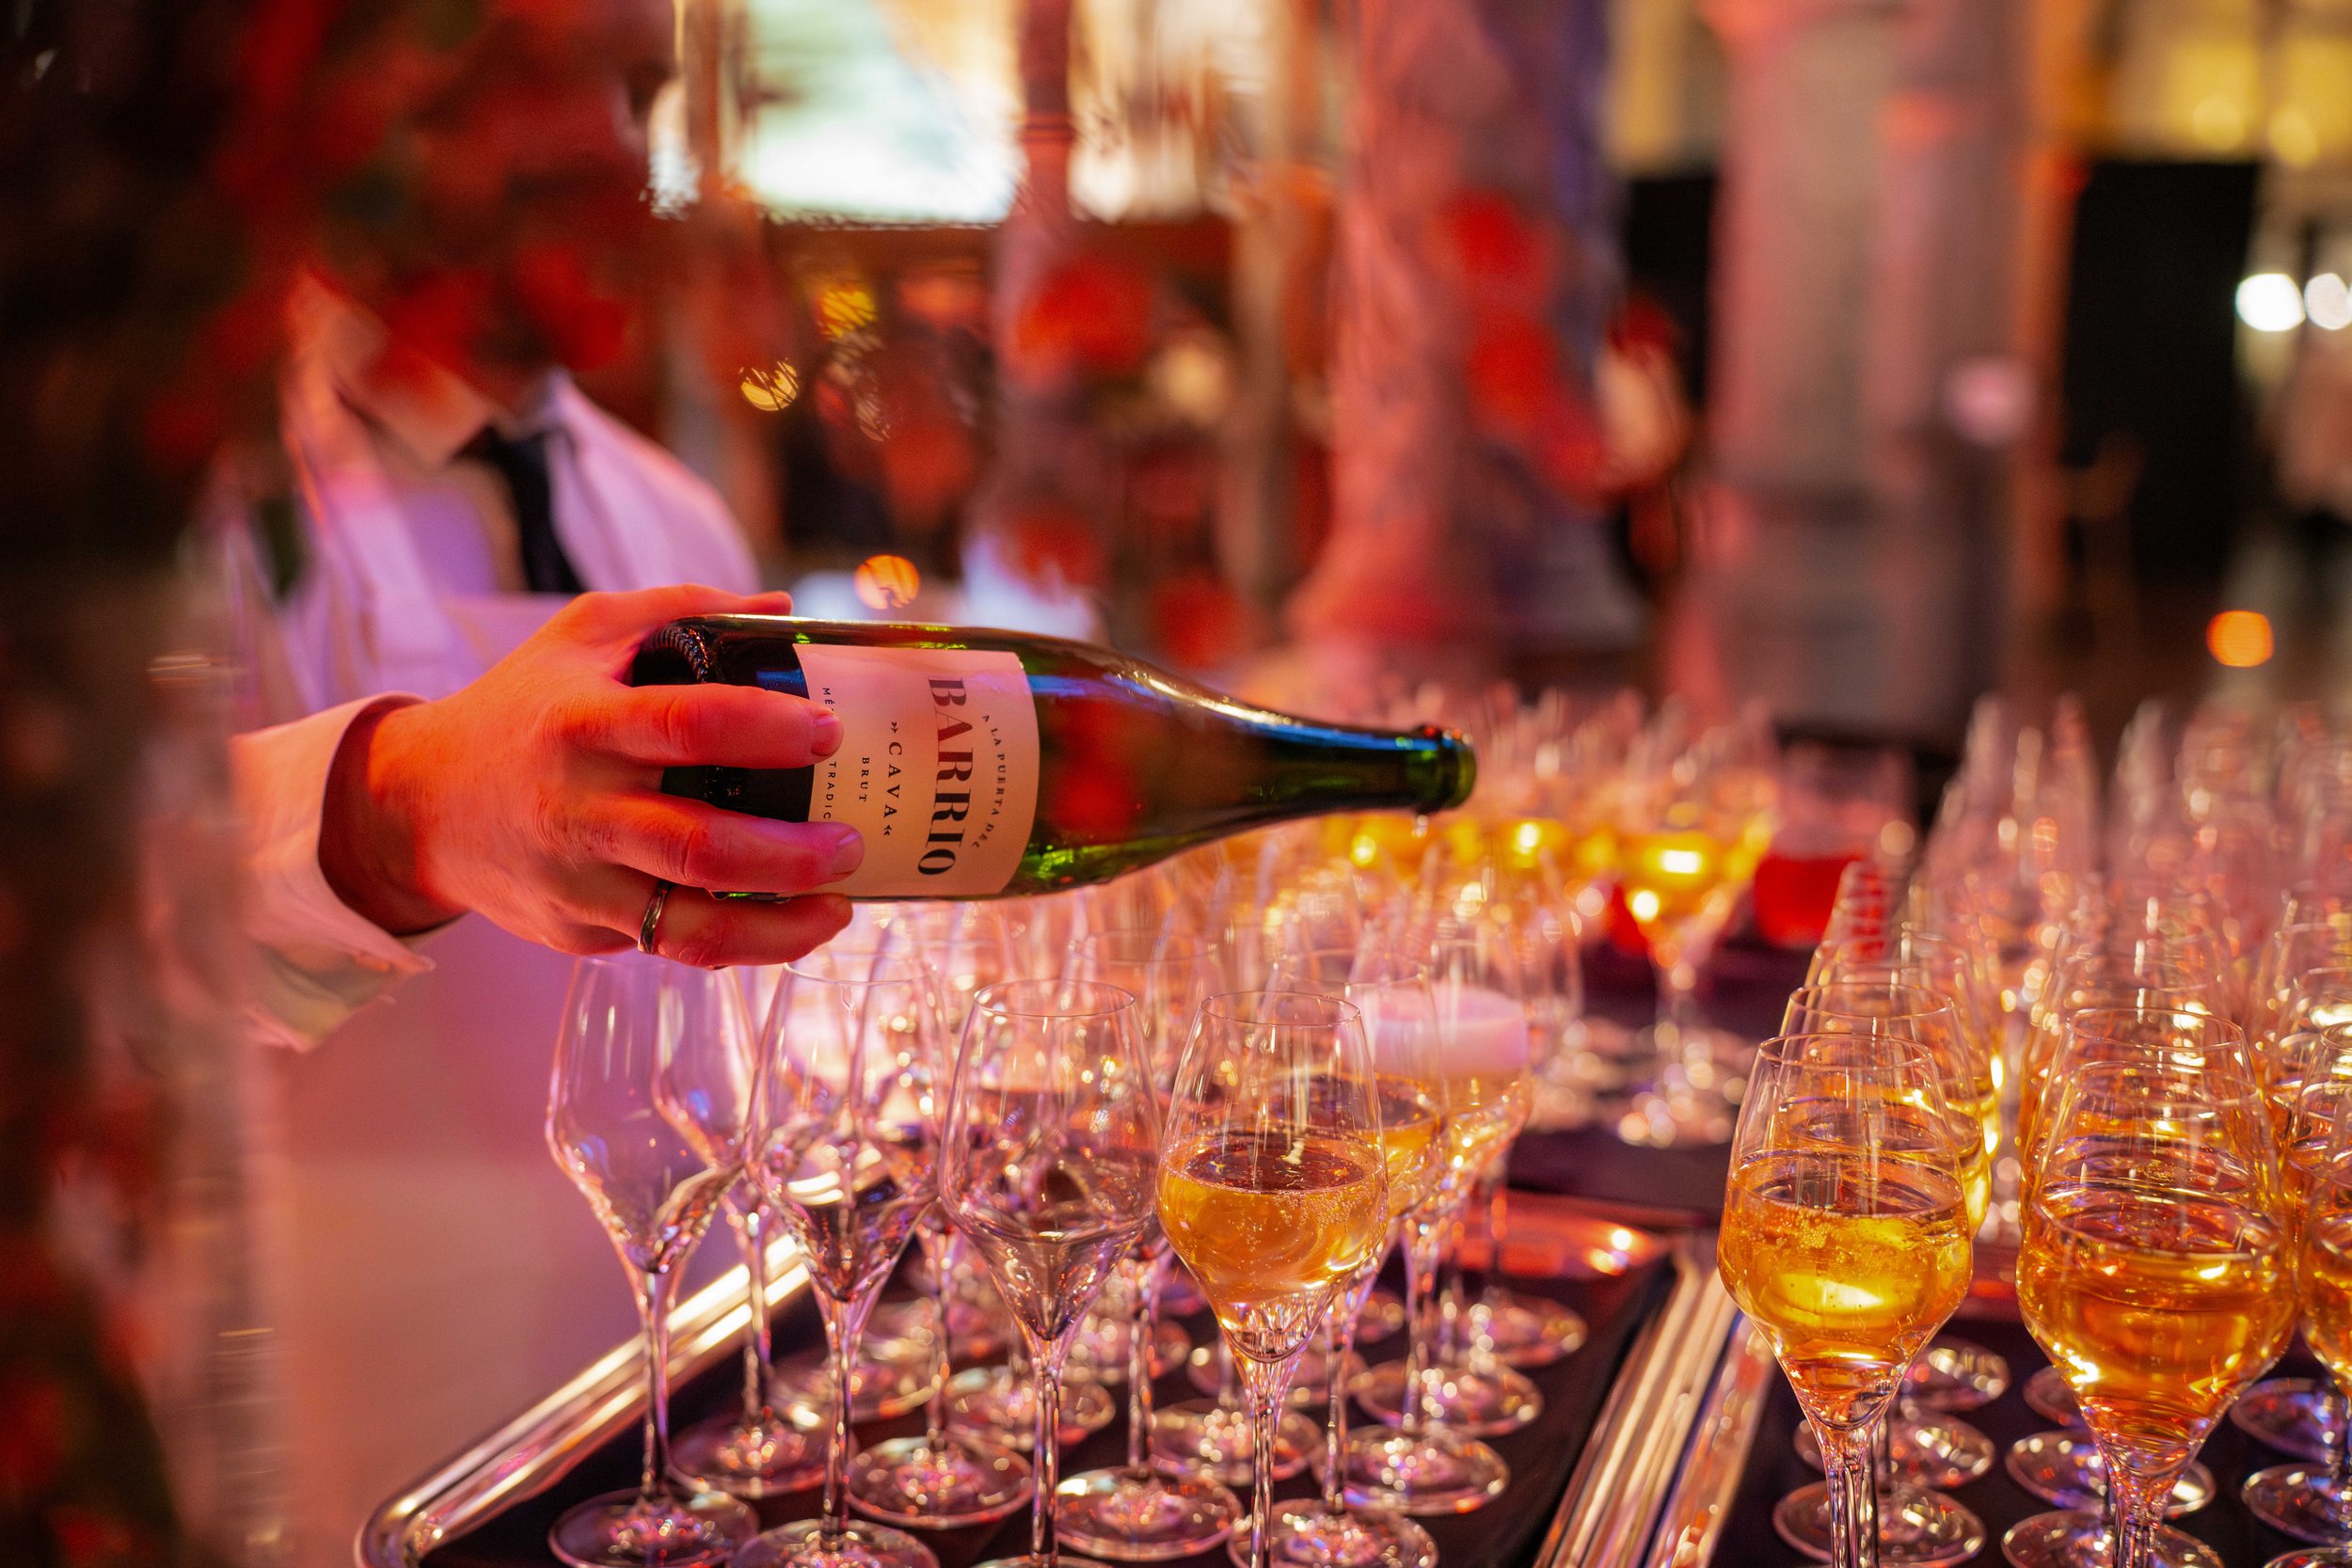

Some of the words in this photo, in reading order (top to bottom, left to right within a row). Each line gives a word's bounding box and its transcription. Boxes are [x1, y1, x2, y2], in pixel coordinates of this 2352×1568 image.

[981, 714, 991, 722] A
[991, 728, 1002, 746] LA
[822, 761, 837, 820] TRADIC
[858, 757, 870, 802] BRUT
[882, 741, 903, 818] CAVA
[917, 677, 974, 876] BARRIO
[991, 753, 1007, 816] PUERTA
[972, 824, 995, 849] DEL
